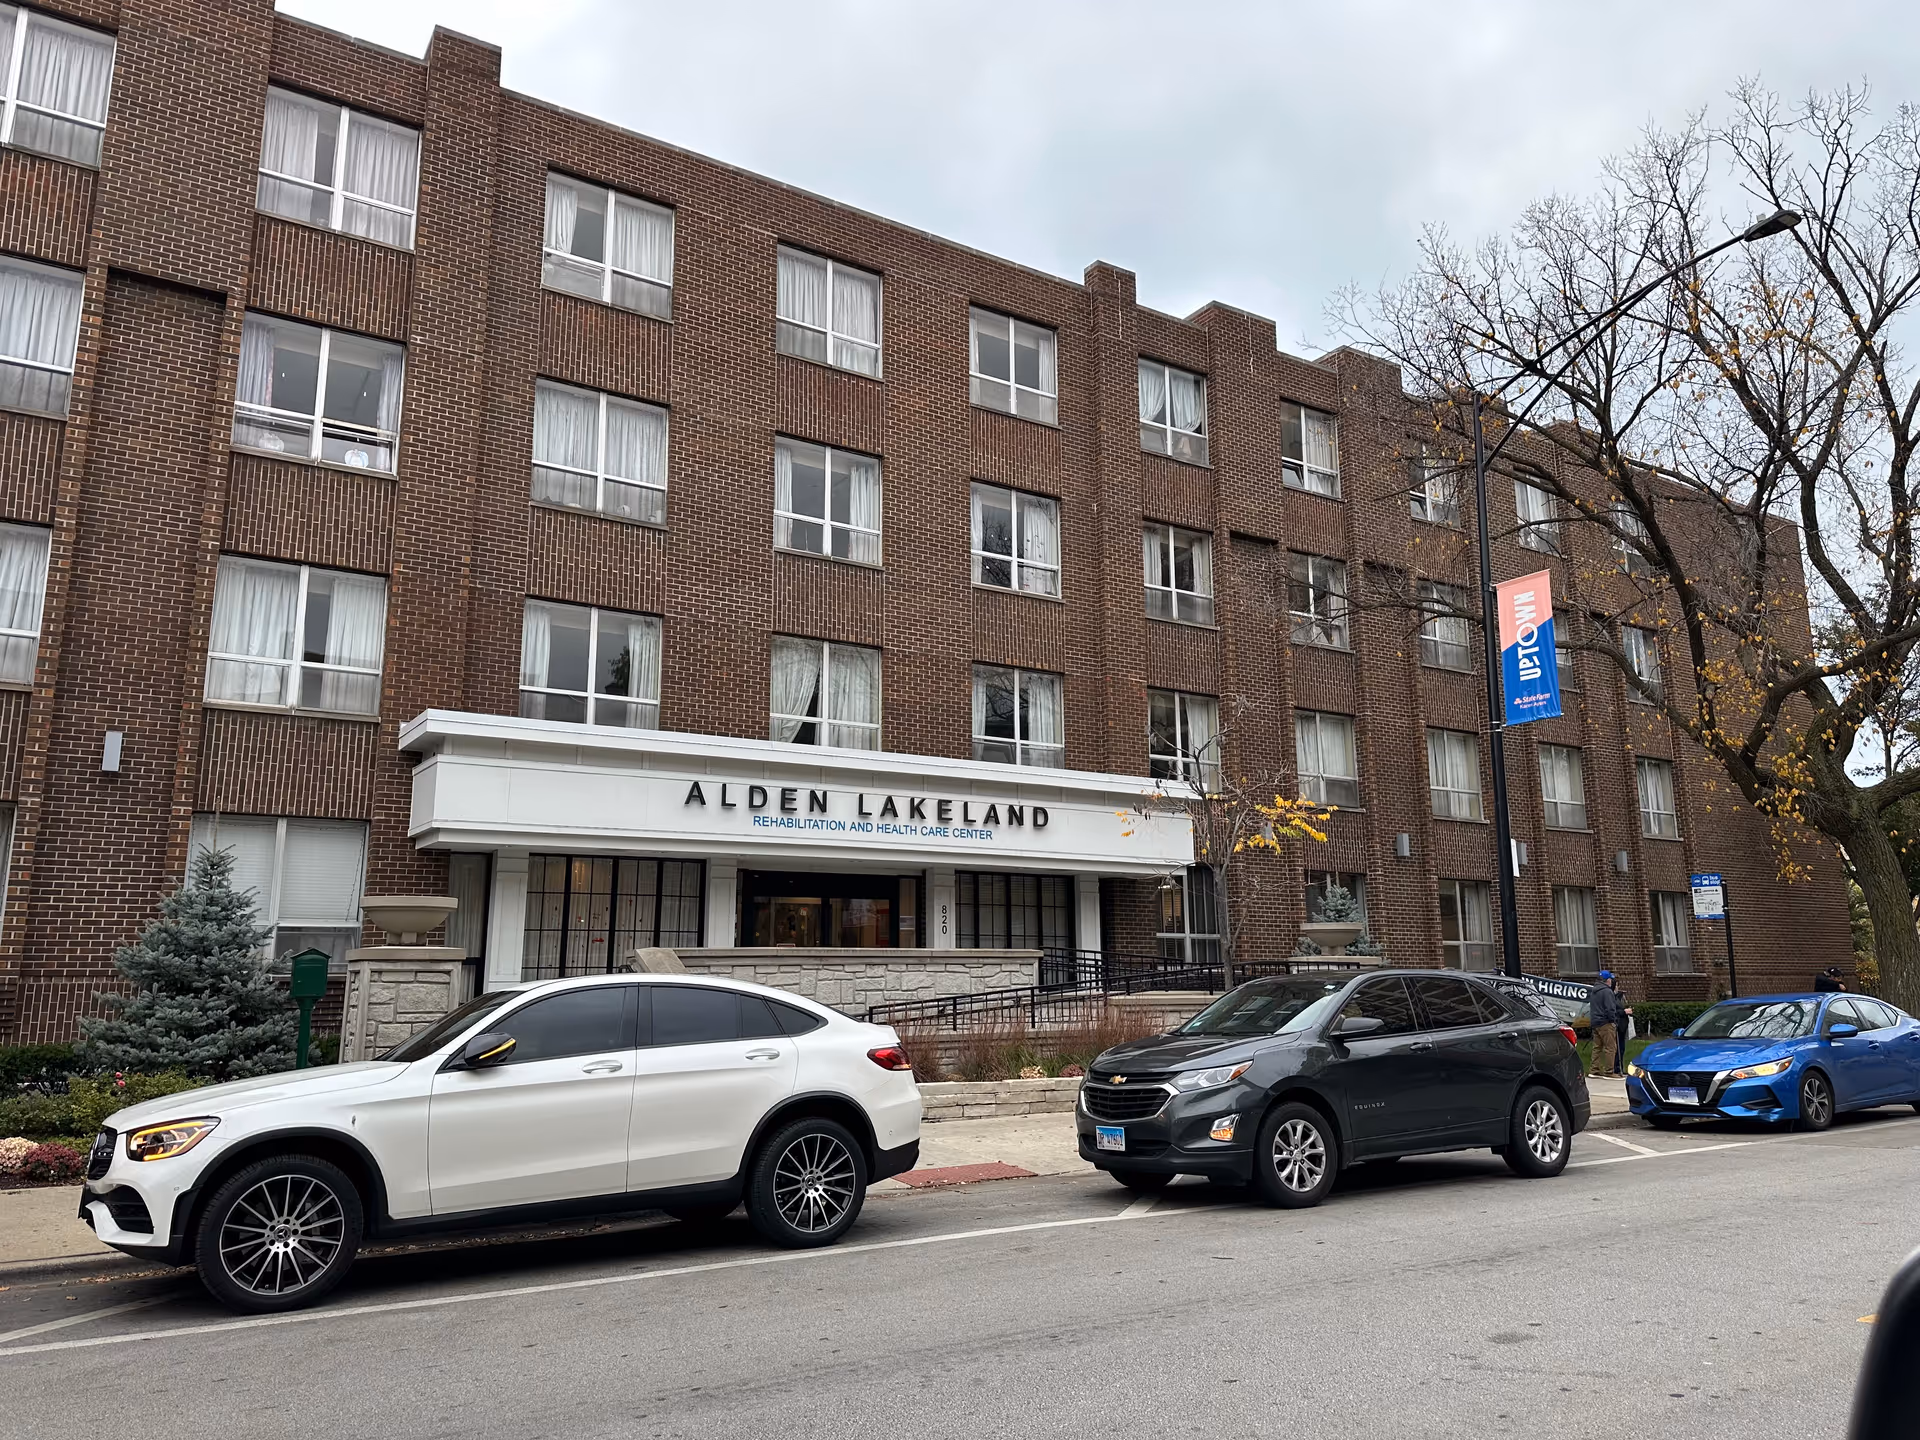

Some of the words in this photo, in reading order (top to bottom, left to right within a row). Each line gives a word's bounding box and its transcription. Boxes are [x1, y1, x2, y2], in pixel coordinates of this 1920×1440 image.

[1513, 590, 1542, 682] UPTOWN
[685, 781, 828, 813] ALDEN
[858, 793, 1050, 828] LAKELAND
[753, 815, 846, 832] REHABILITATION
[849, 821, 873, 833] AND
[876, 823, 918, 836] HEALTH
[920, 825, 949, 838] CARE
[953, 827, 993, 840] CENTER
[1538, 980, 1588, 999] HIRING
[1354, 1101, 1386, 1110] EQUINOX
